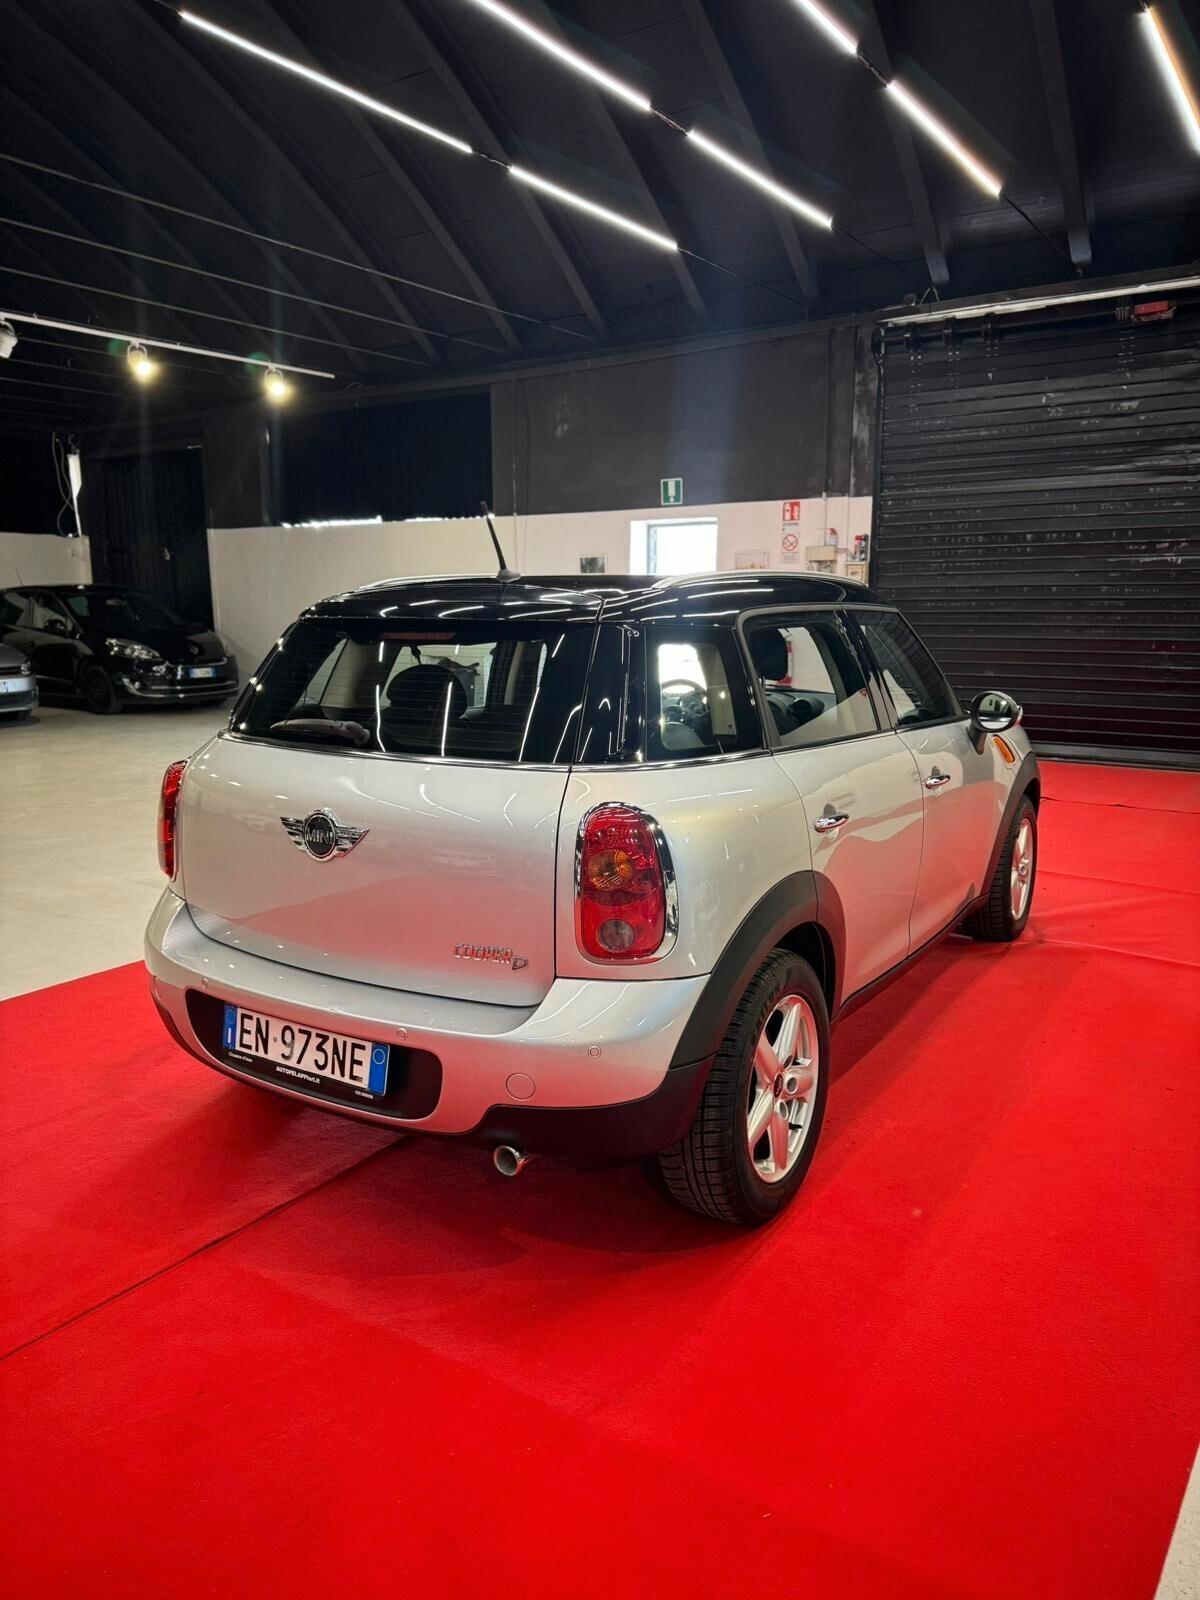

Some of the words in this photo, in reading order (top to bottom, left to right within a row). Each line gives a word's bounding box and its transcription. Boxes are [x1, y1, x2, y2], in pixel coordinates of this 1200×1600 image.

[306, 827, 333, 844] MINI
[453, 943, 513, 965] COOPER
[511, 955, 529, 971] D
